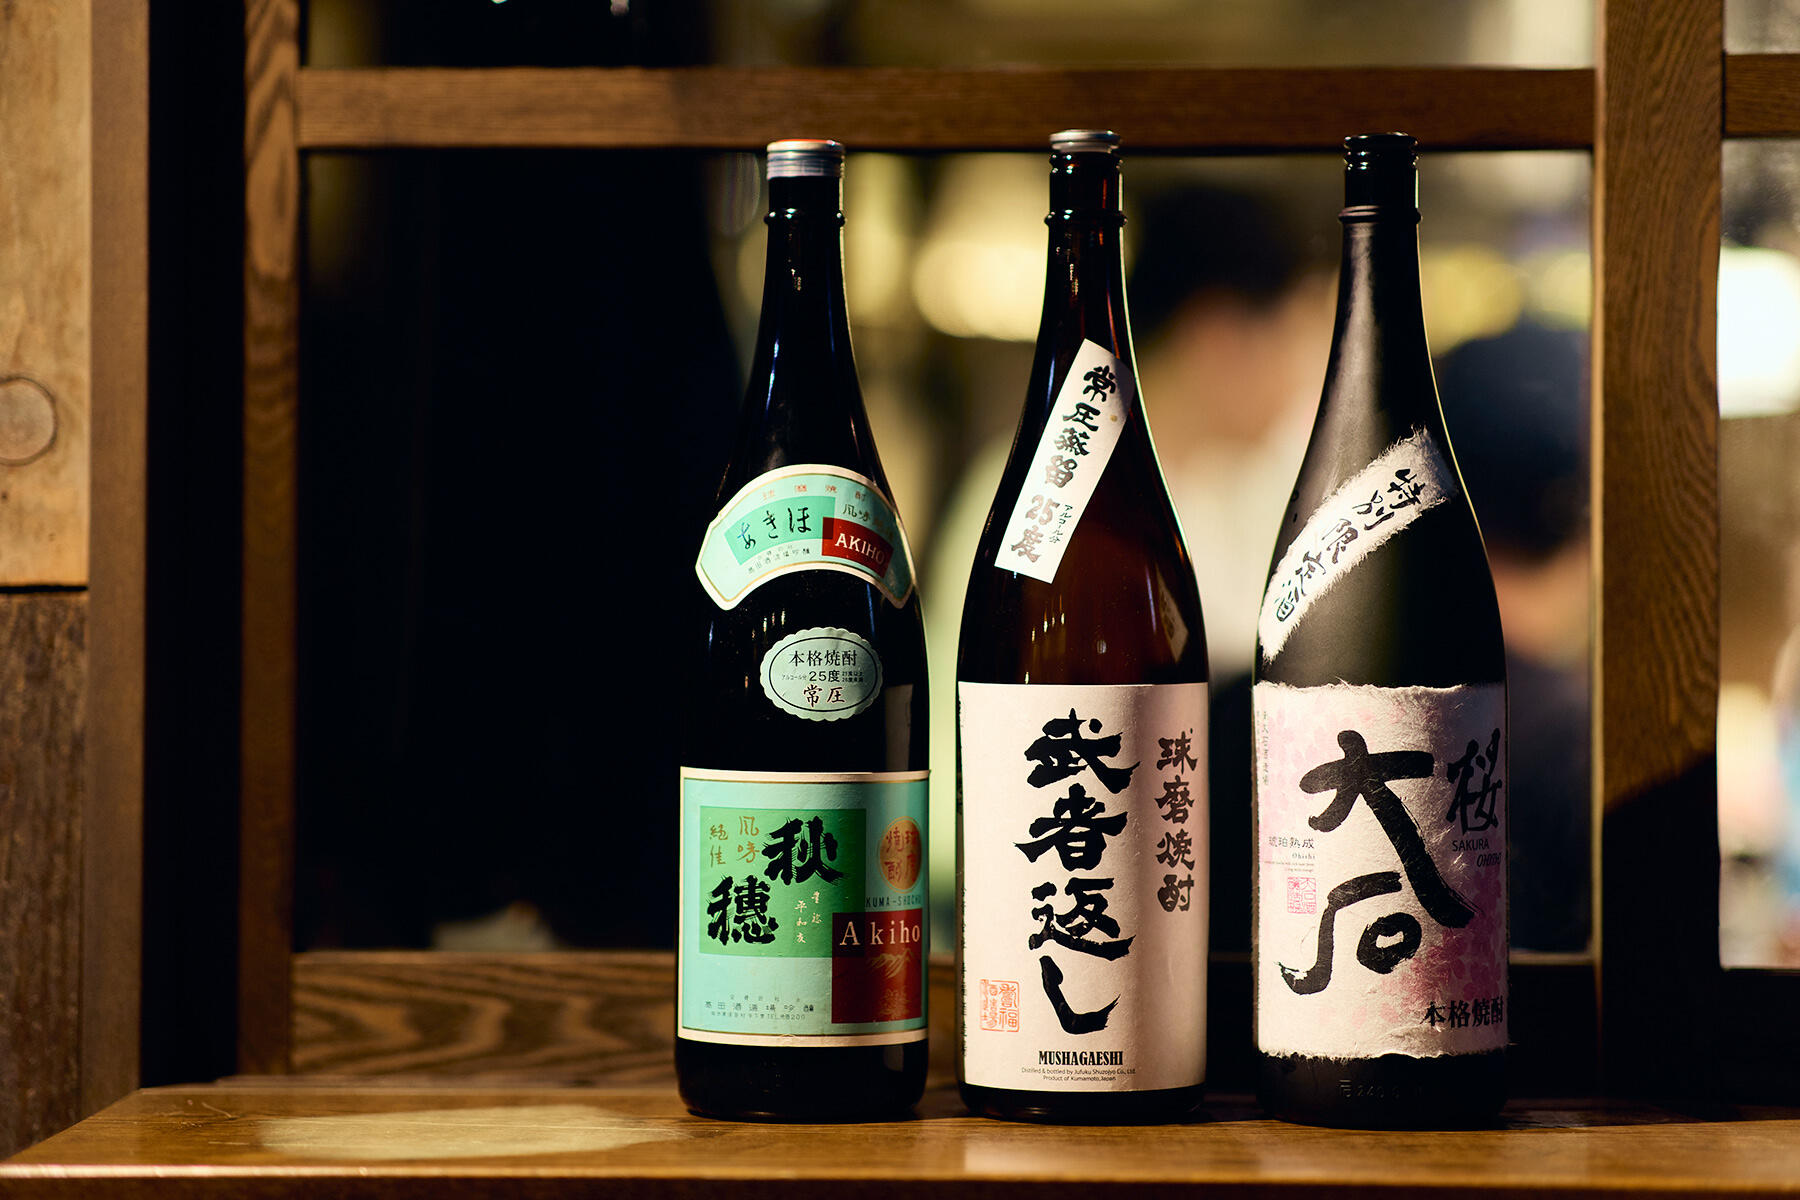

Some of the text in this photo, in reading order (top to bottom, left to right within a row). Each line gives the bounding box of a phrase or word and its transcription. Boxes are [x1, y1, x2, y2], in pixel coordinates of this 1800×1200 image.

[737, 507, 812, 550] あきほ
[835, 532, 887, 565] AKIHO
[789, 650, 858, 669] 本格焼酎
[803, 684, 846, 708] 常圧
[1446, 728, 1503, 835] 桜
[1155, 728, 1198, 913] 球磨焼酎
[1452, 838, 1490, 851] SAKURA
[1014, 708, 1141, 1035] 武者返し
[839, 920, 921, 946] Akiho
[1421, 996, 1504, 1029] 本格焼酎
[1038, 1050, 1124, 1066] MUSHAGAESHI
